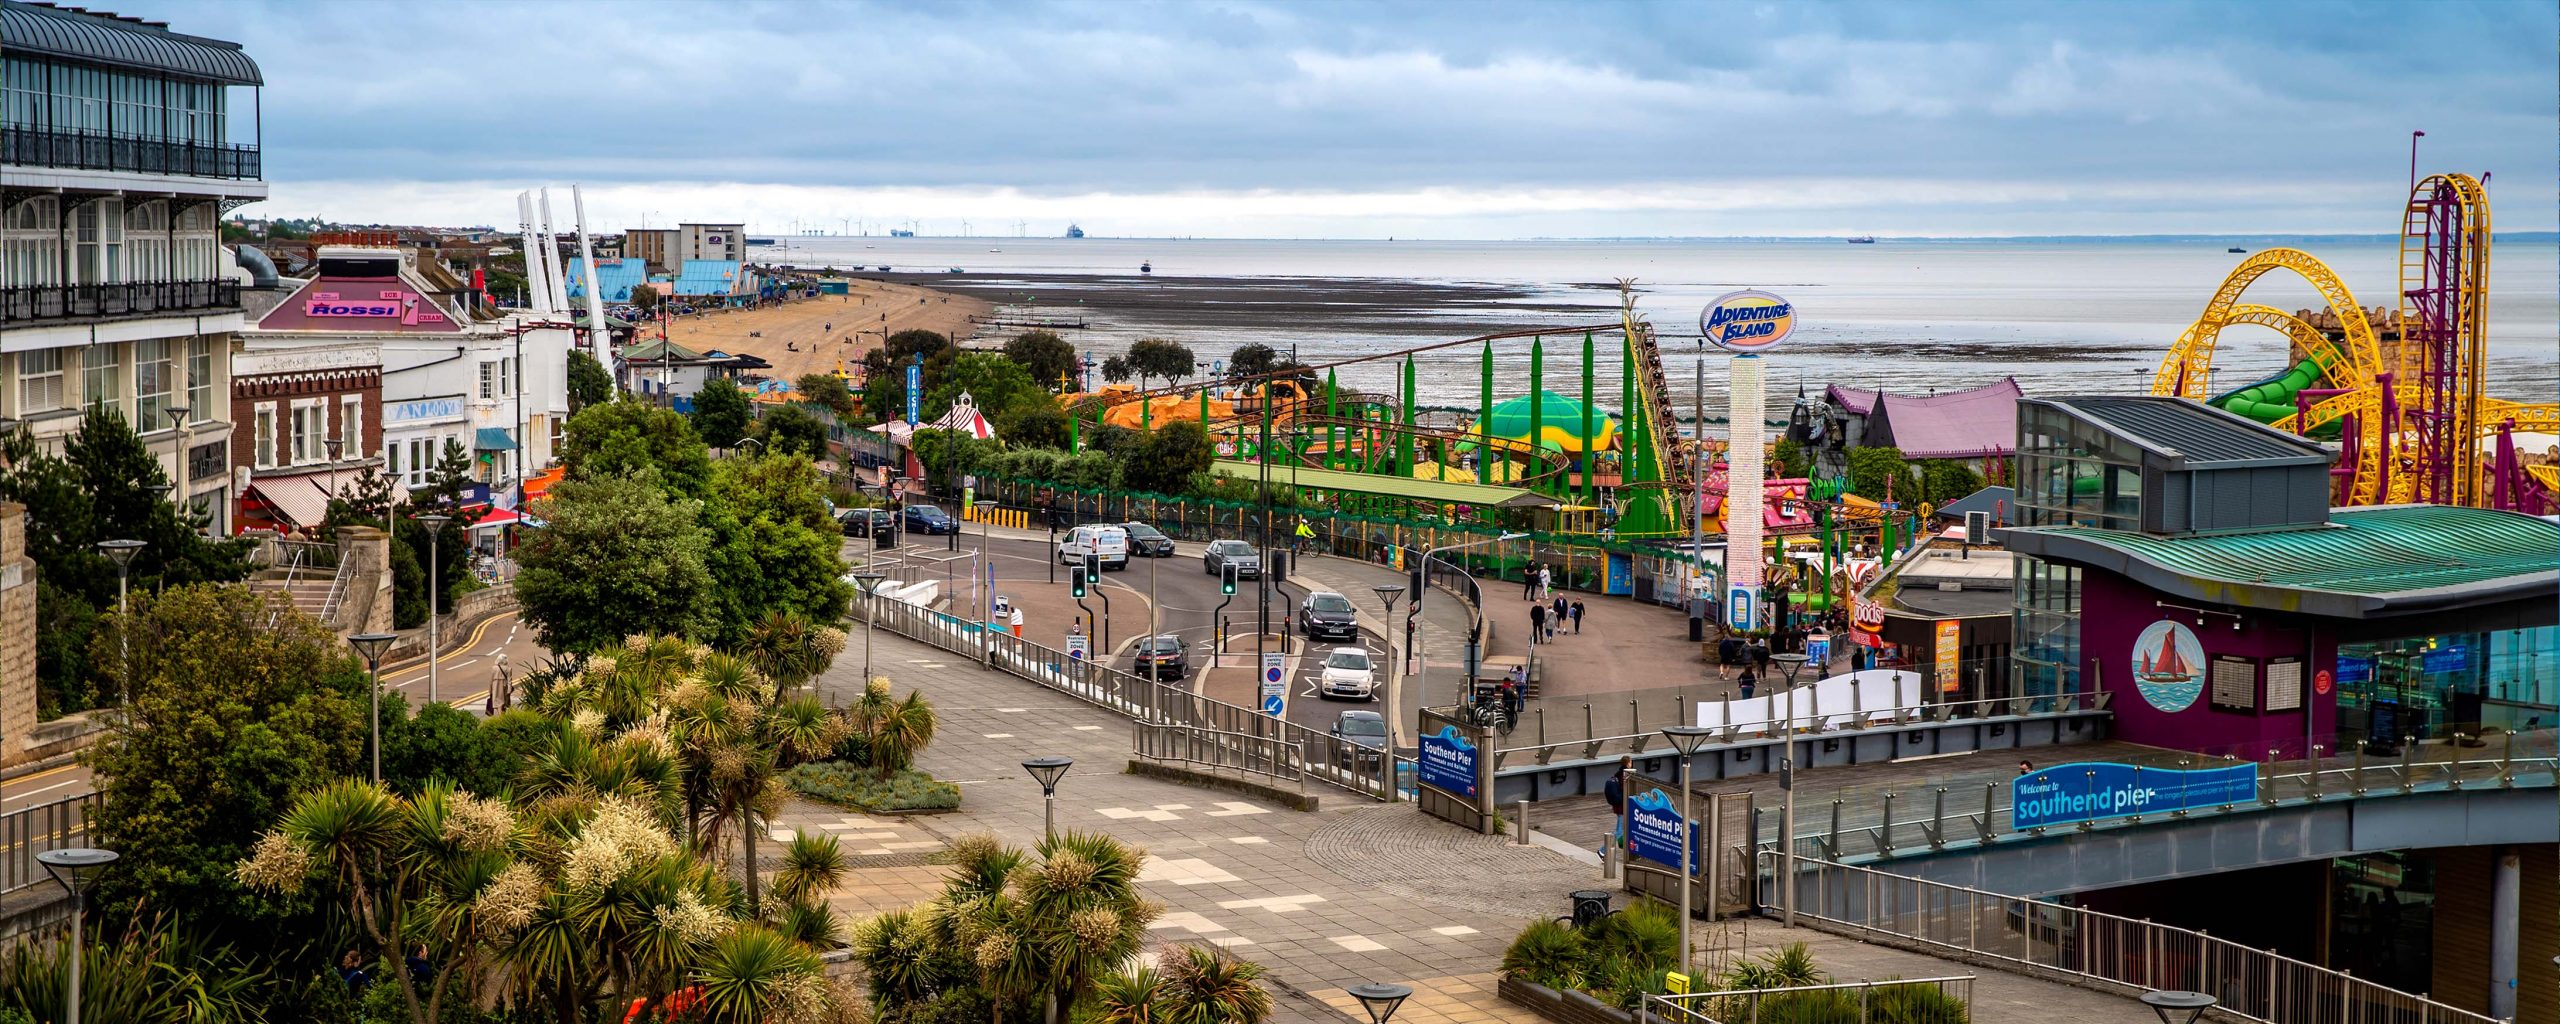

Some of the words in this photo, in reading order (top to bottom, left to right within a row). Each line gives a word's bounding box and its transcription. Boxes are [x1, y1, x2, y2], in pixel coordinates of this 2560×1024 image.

[311, 305, 395, 316] ROSSI
[1706, 303, 1792, 329] ADVENTURE
[1720, 321, 1775, 344] ISLAND
[1424, 741, 1456, 762] Southend
[1457, 751, 1472, 766] Pier
[1428, 754, 1447, 766] Promenade
[1454, 763, 1468, 773] Railway
[2019, 783, 2051, 795] Welcome
[2052, 782, 2060, 791] to
[2019, 786, 2111, 819] southend
[2115, 783, 2152, 813] pier
[1633, 808, 1673, 833] Southend
[1638, 824, 1661, 837] Promenade
[1661, 832, 1670, 840] and
